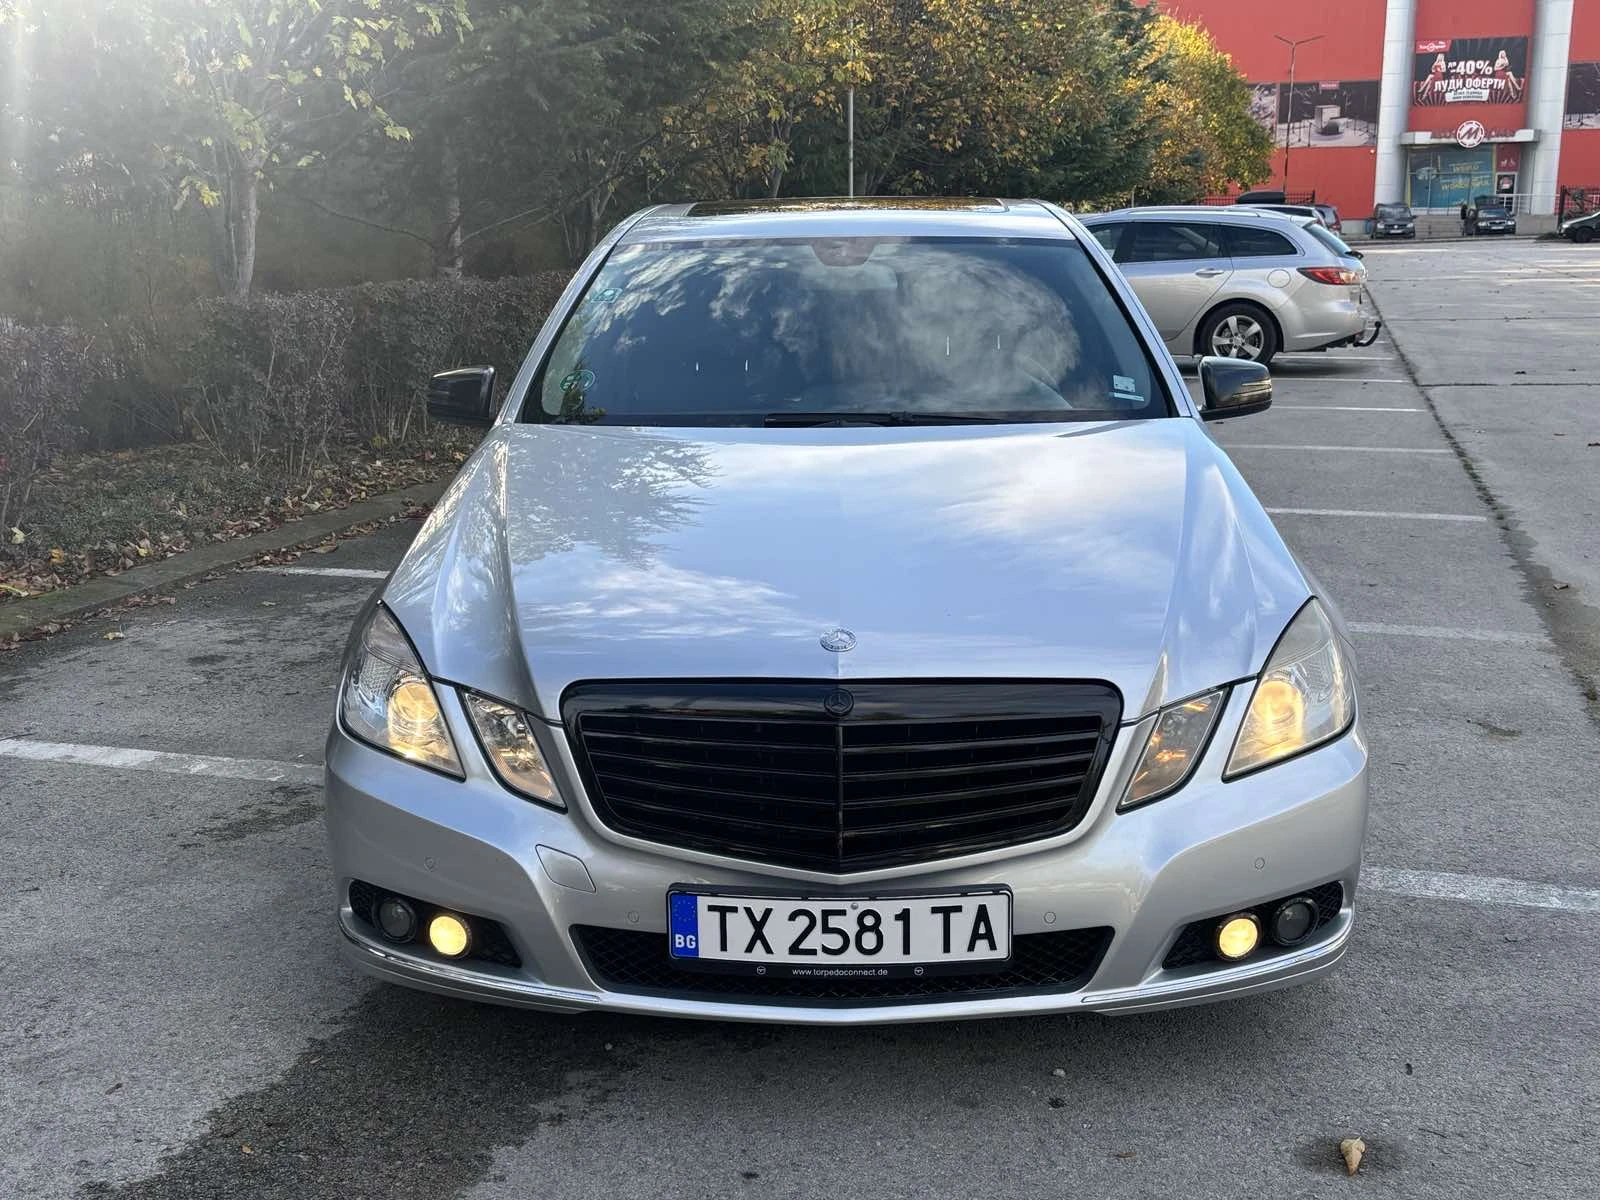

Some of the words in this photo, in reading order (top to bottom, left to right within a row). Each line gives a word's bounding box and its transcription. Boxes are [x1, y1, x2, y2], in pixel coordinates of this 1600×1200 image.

[1434, 78, 1464, 92] ЛУДИ
[1466, 78, 1505, 90] ОФЕРТИ
[707, 904, 774, 955] TX
[788, 907, 912, 956] 2581
[930, 903, 998, 953] TA
[674, 934, 697, 950] BG
[792, 968, 888, 977] www.torpedoconnect.de
